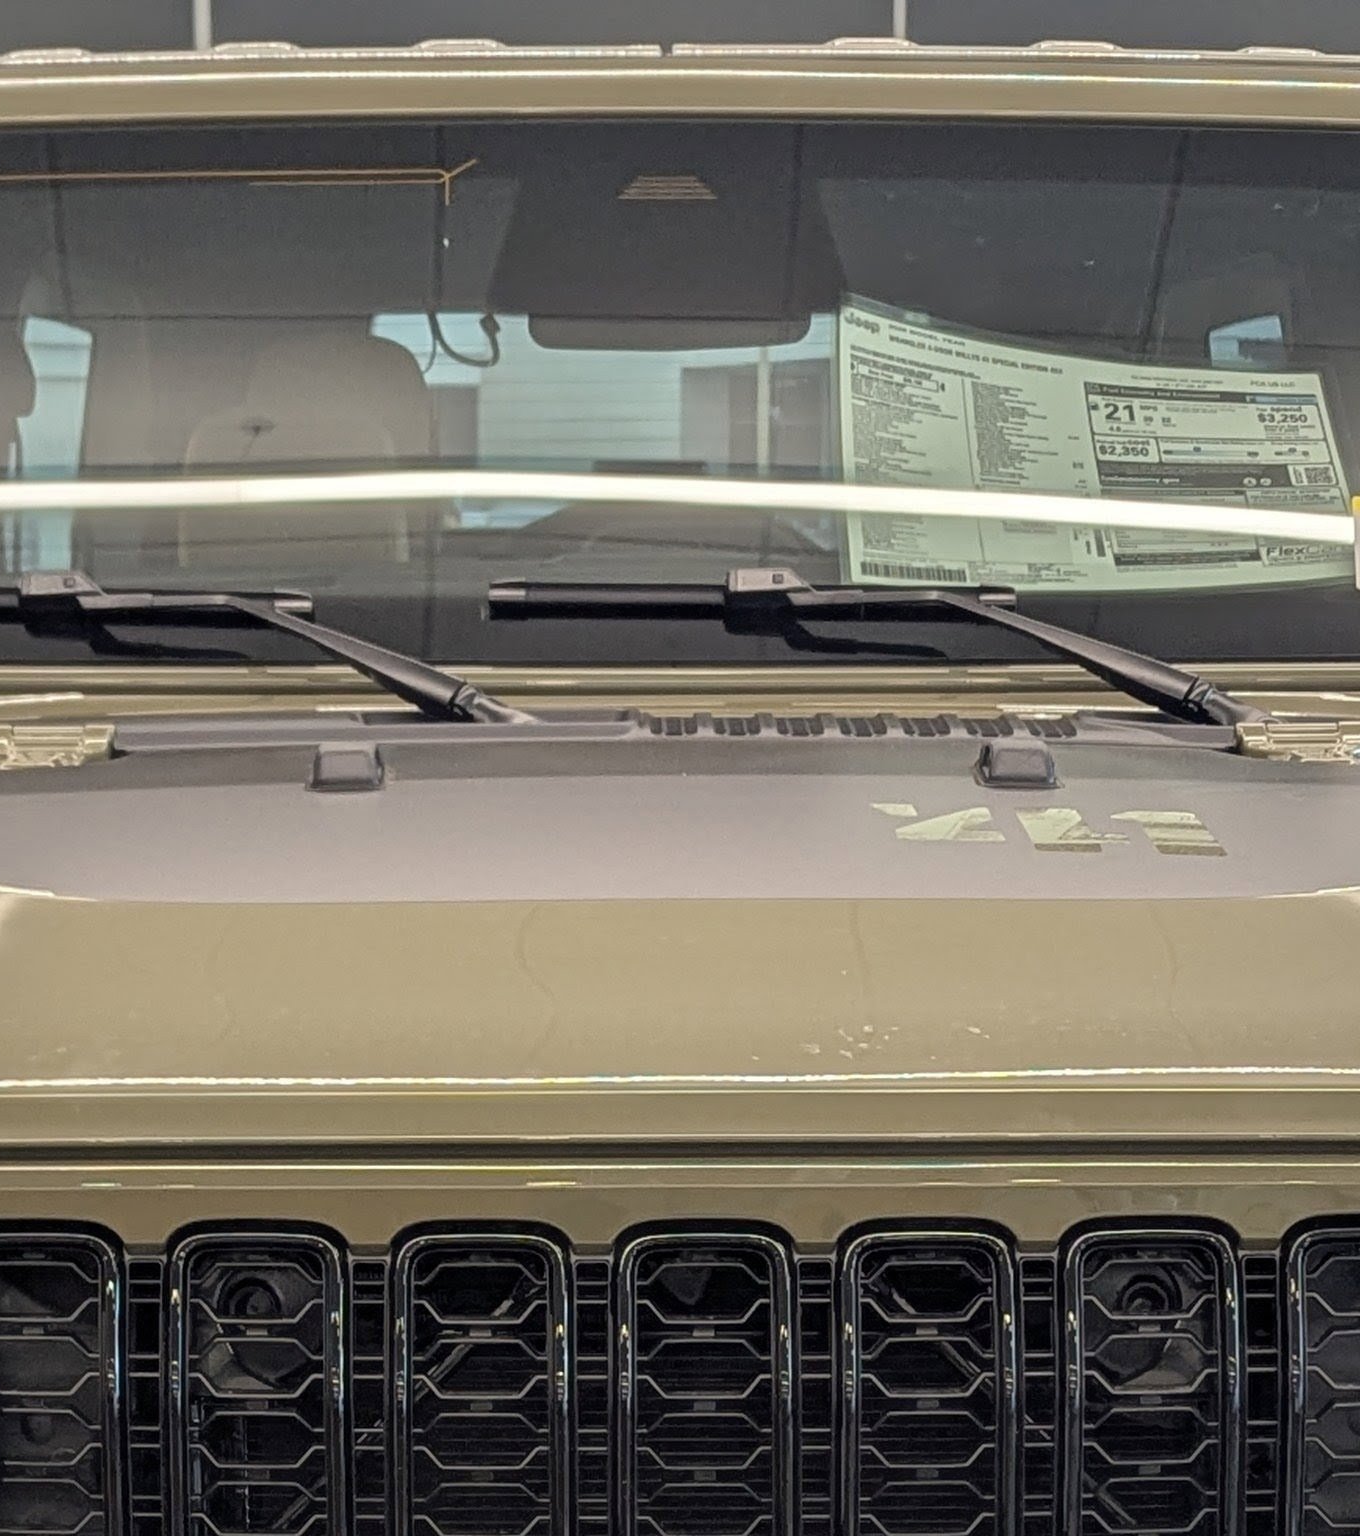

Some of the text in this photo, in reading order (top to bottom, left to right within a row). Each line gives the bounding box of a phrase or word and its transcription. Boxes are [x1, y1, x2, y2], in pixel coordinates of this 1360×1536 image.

[843, 312, 880, 334] Jeep
[1104, 402, 1136, 422] 21
[1257, 413, 1308, 424] $3,250
[1098, 444, 1150, 457] $2,350
